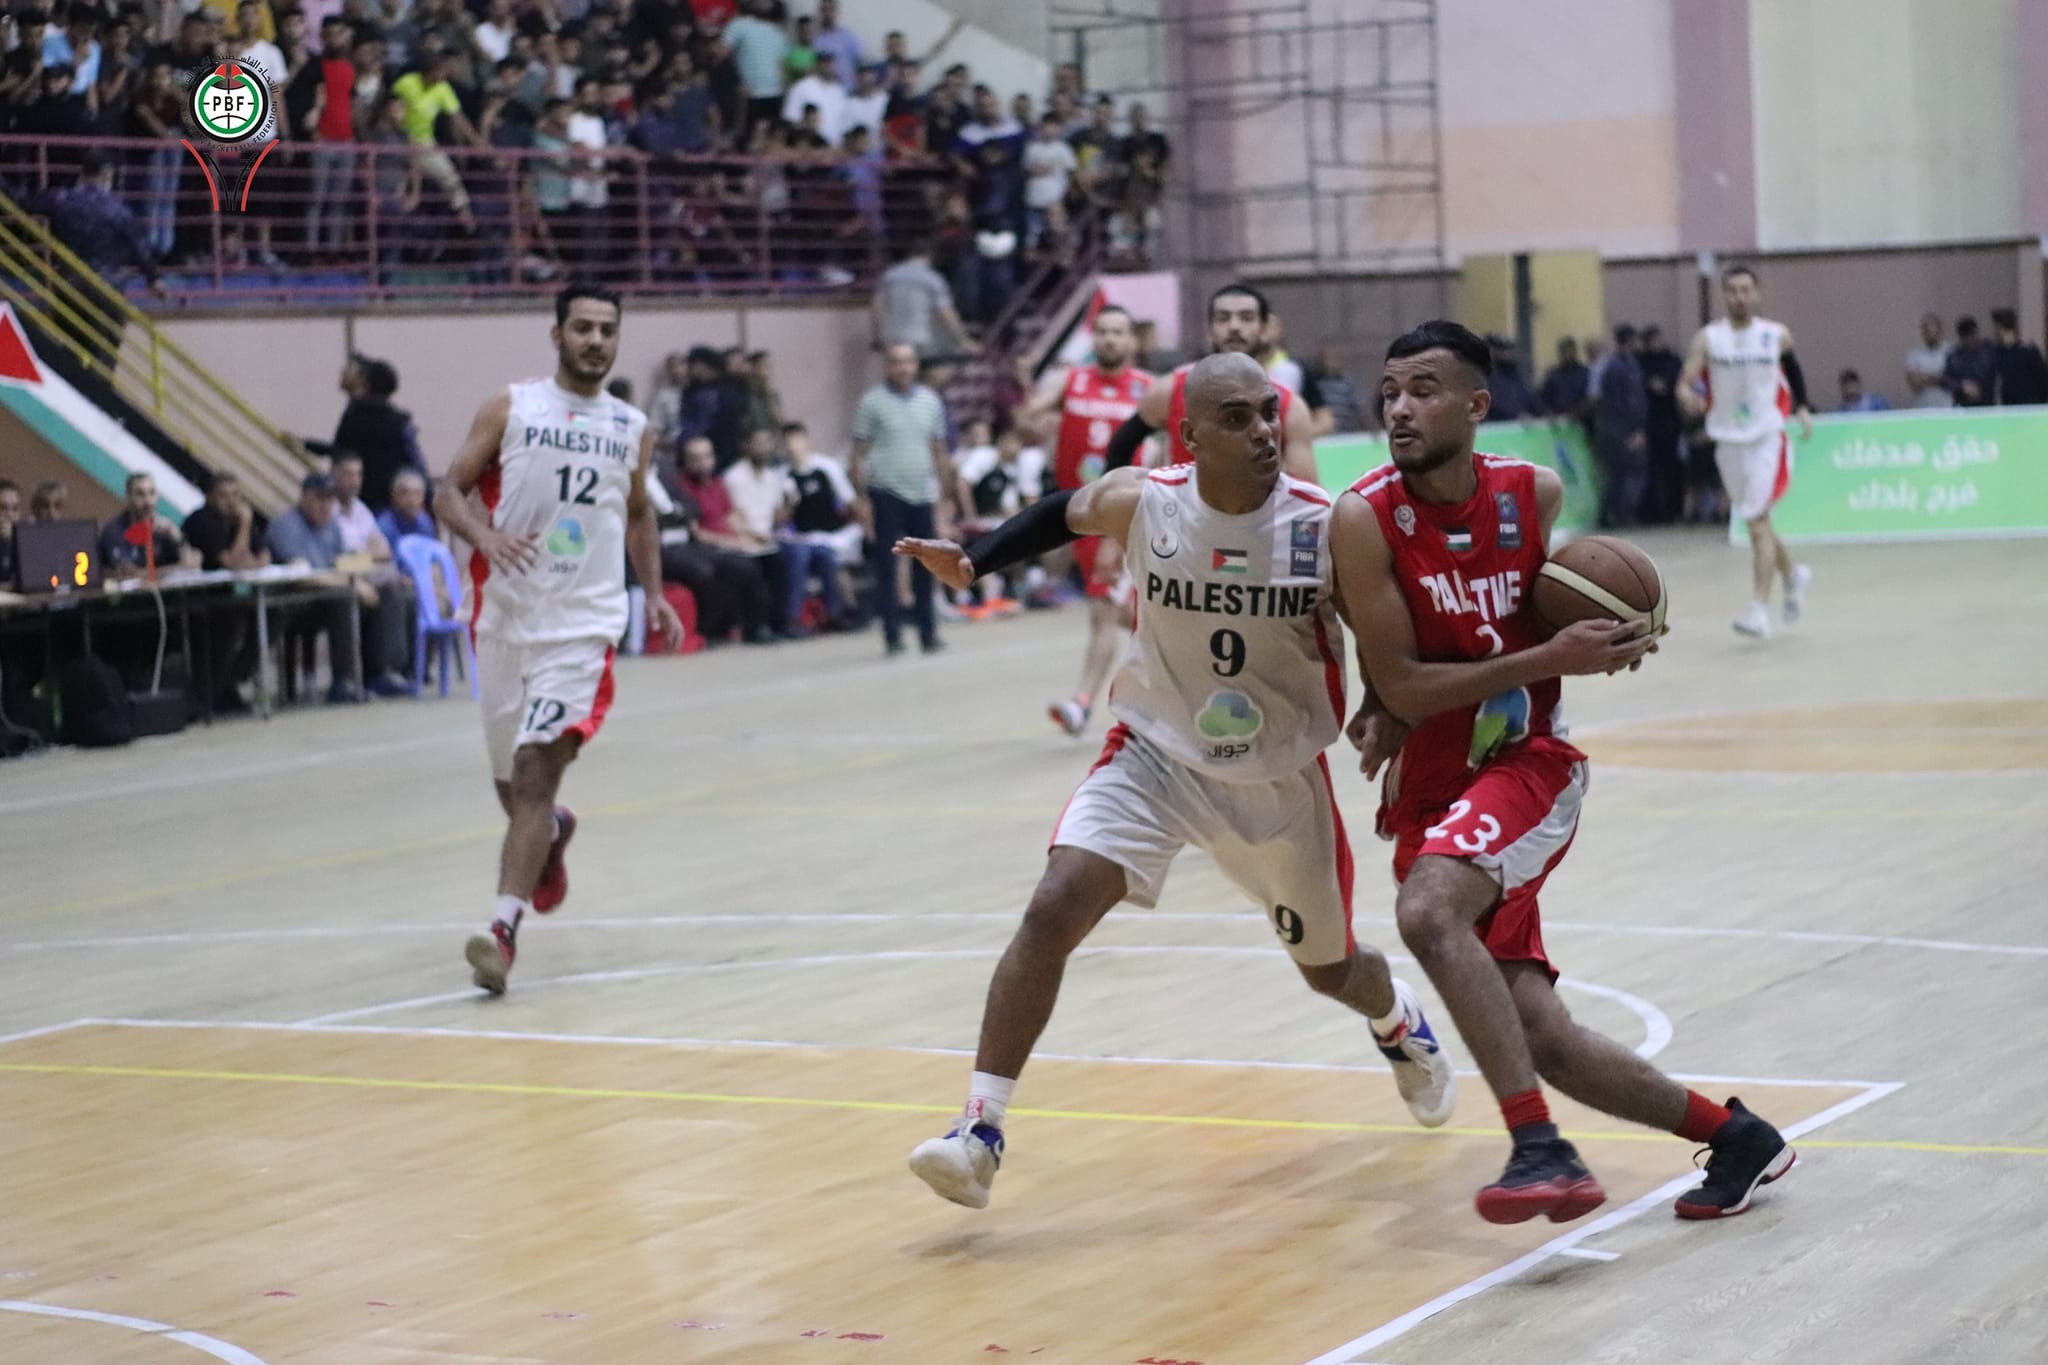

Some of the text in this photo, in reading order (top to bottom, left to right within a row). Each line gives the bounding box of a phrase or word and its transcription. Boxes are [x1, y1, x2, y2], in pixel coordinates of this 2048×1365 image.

[555, 464, 599, 506] 12
[1147, 571, 1318, 618] PALESTINE
[1209, 628, 1246, 677] 9
[525, 697, 566, 731] 12
[1207, 743, 1250, 759] جوال
[1424, 799, 1501, 852] 23
[1275, 904, 1304, 945] 9
